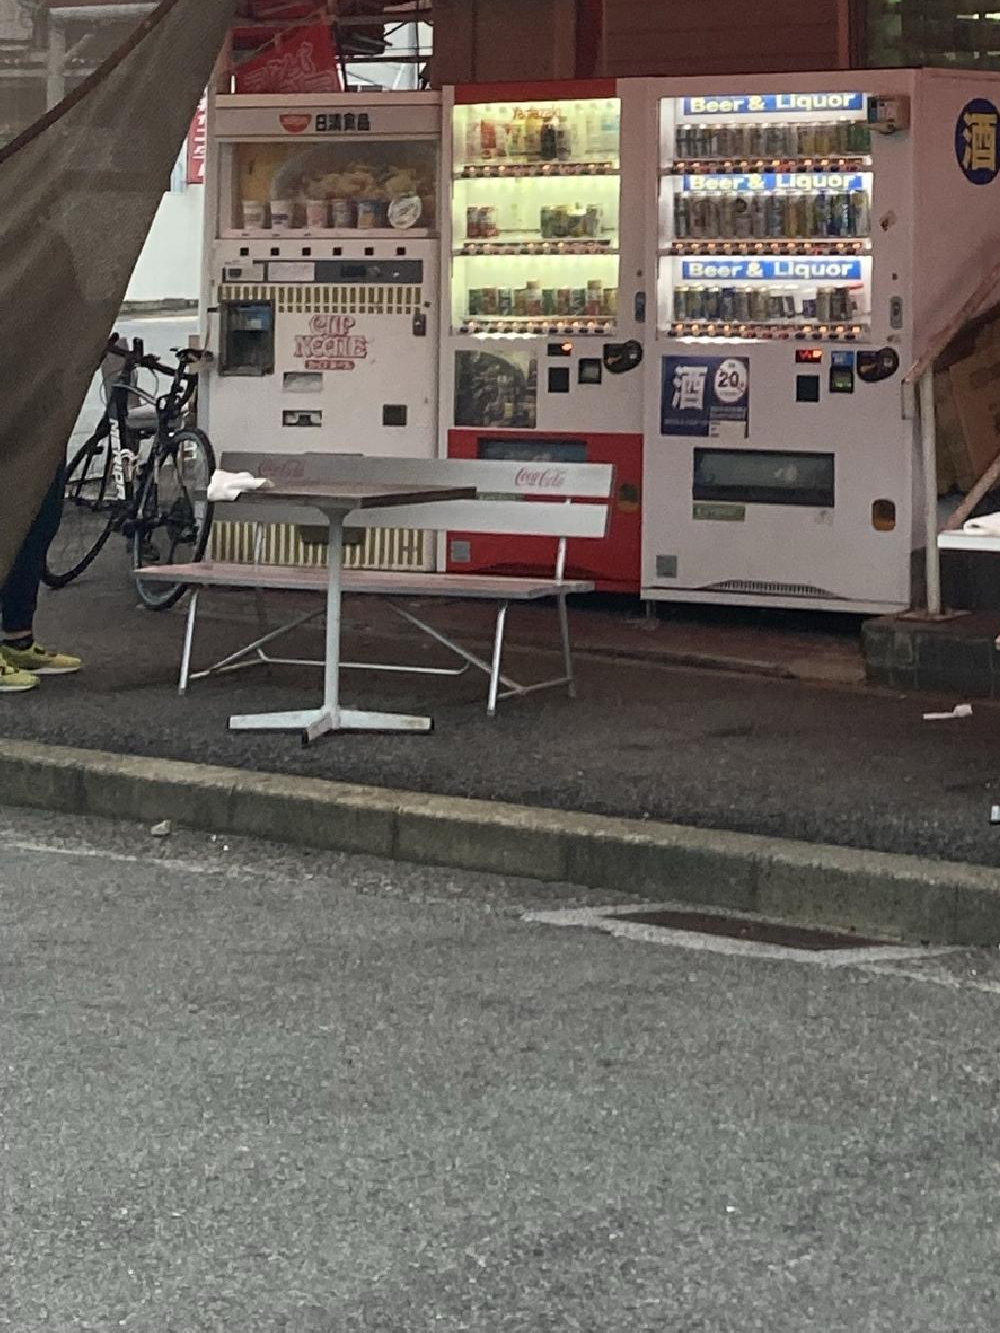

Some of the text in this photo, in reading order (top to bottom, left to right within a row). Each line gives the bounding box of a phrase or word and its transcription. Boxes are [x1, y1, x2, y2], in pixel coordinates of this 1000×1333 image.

[690, 92, 857, 114] Beer & Liquor
[962, 112, 998, 171] 酒
[689, 171, 857, 191] Beer & Liquor
[688, 260, 854, 280] Beer & Liquor
[671, 365, 708, 411] 酒
[717, 370, 739, 388] 20
